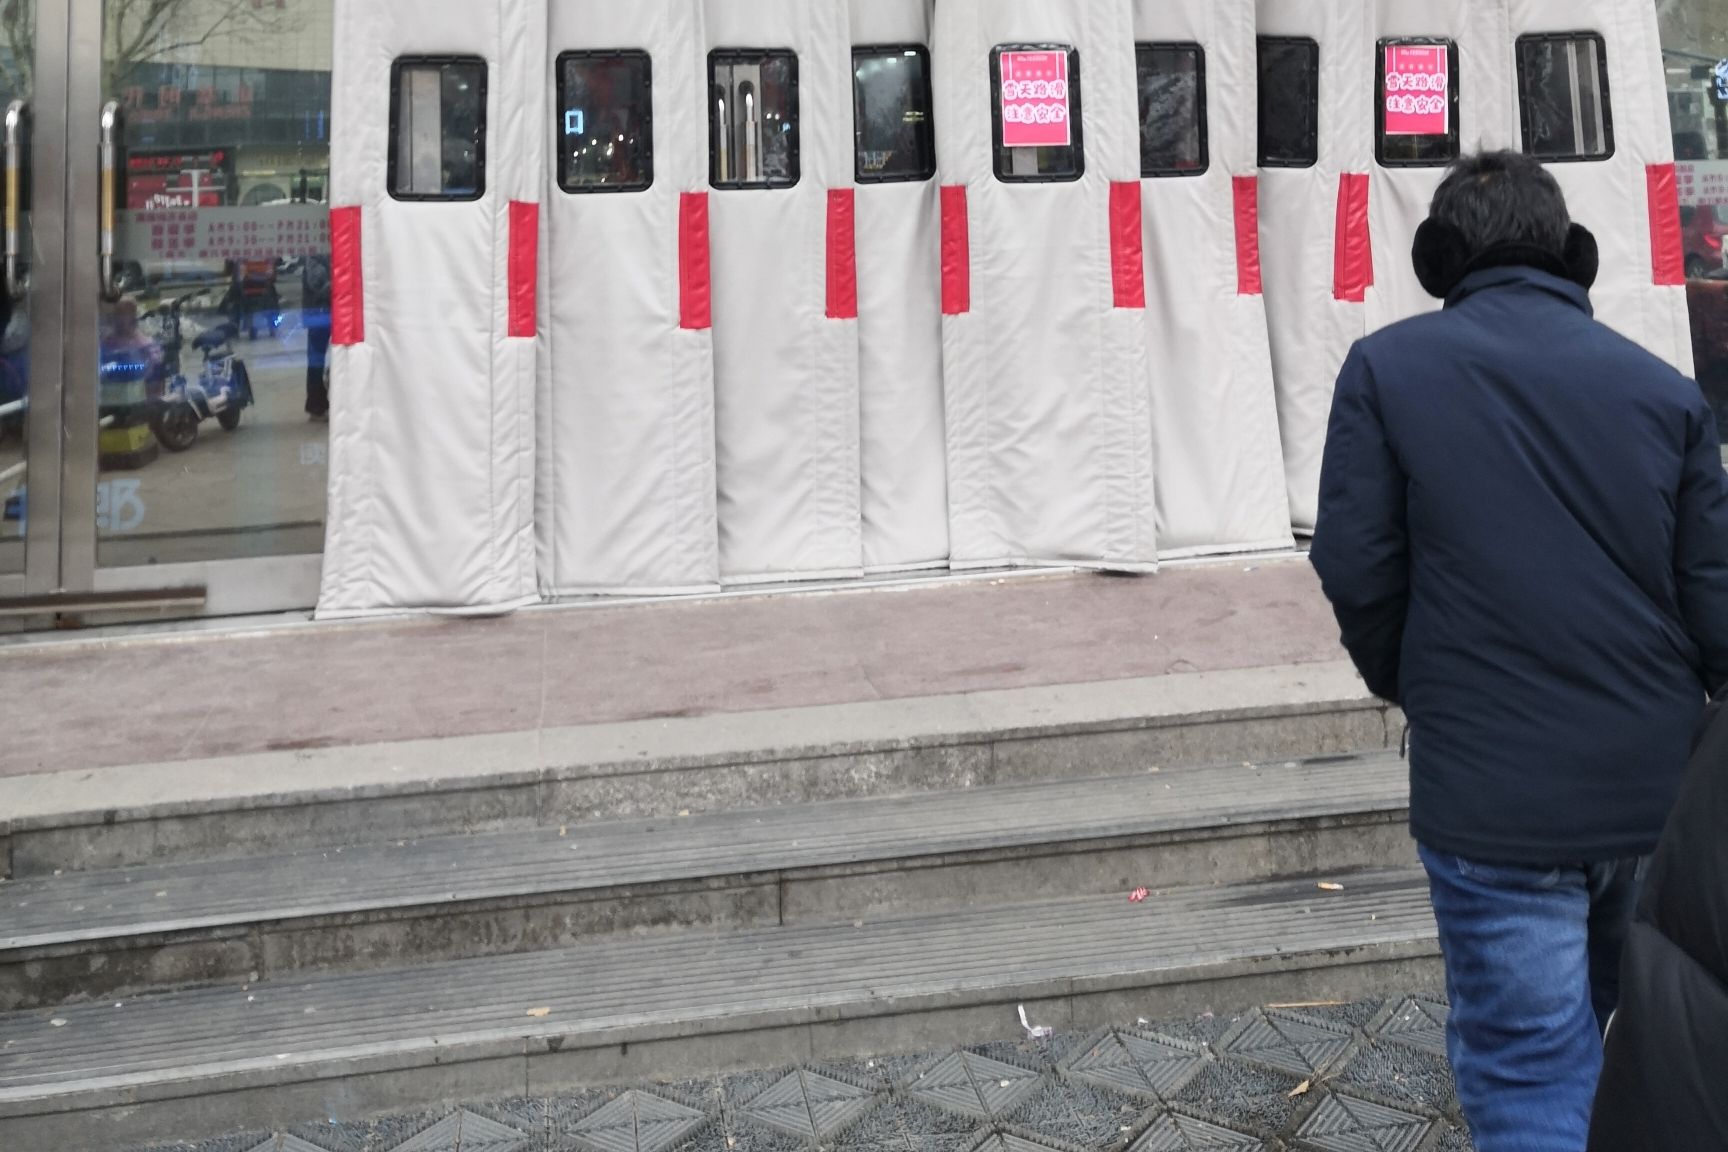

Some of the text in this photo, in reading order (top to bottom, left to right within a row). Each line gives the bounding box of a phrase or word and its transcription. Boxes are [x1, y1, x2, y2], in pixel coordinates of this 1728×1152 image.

[1004, 103, 1066, 124] 注意安全
[1386, 94, 1445, 114] 注意安全
